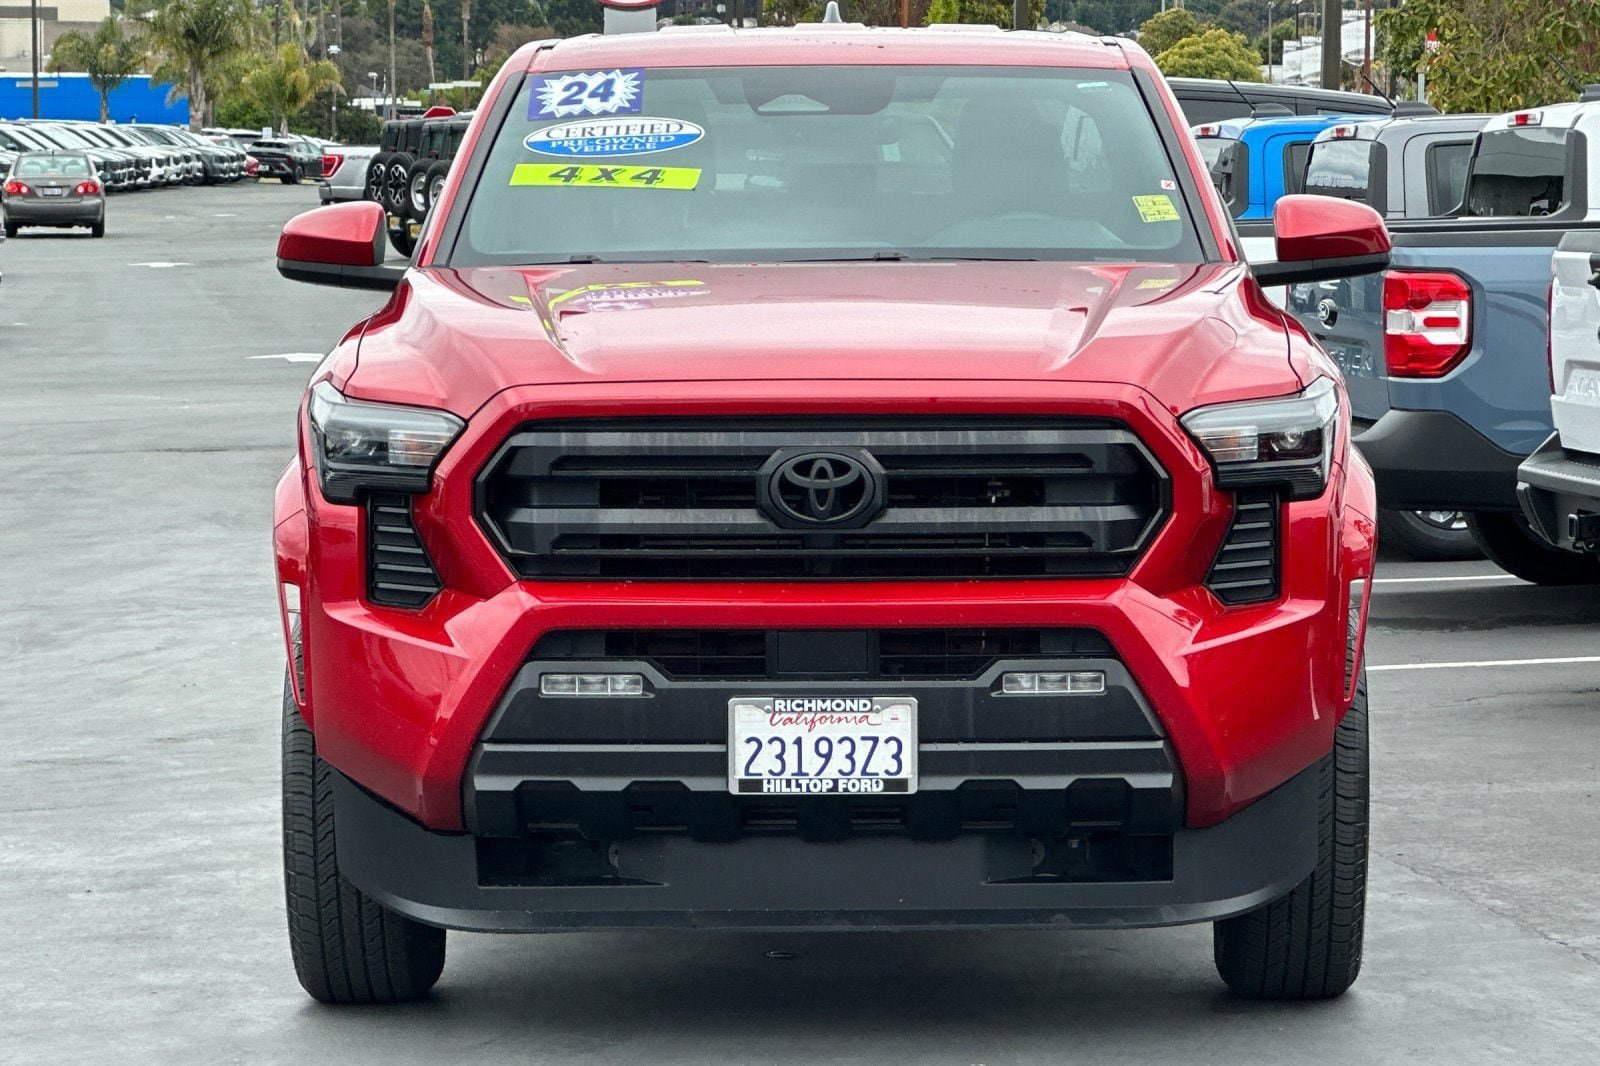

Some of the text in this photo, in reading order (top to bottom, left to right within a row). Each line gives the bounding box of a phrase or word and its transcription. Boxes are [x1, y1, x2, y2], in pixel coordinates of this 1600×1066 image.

[557, 77, 616, 107] 24
[545, 122, 684, 139] CERTIFIED
[550, 135, 676, 148] PRE-OWNED
[567, 142, 657, 153] VEHICLE
[774, 699, 872, 712] RICHMOND
[769, 712, 883, 733] California
[743, 735, 903, 777] 23193Z3
[762, 779, 884, 793] HILLTOP FORD
